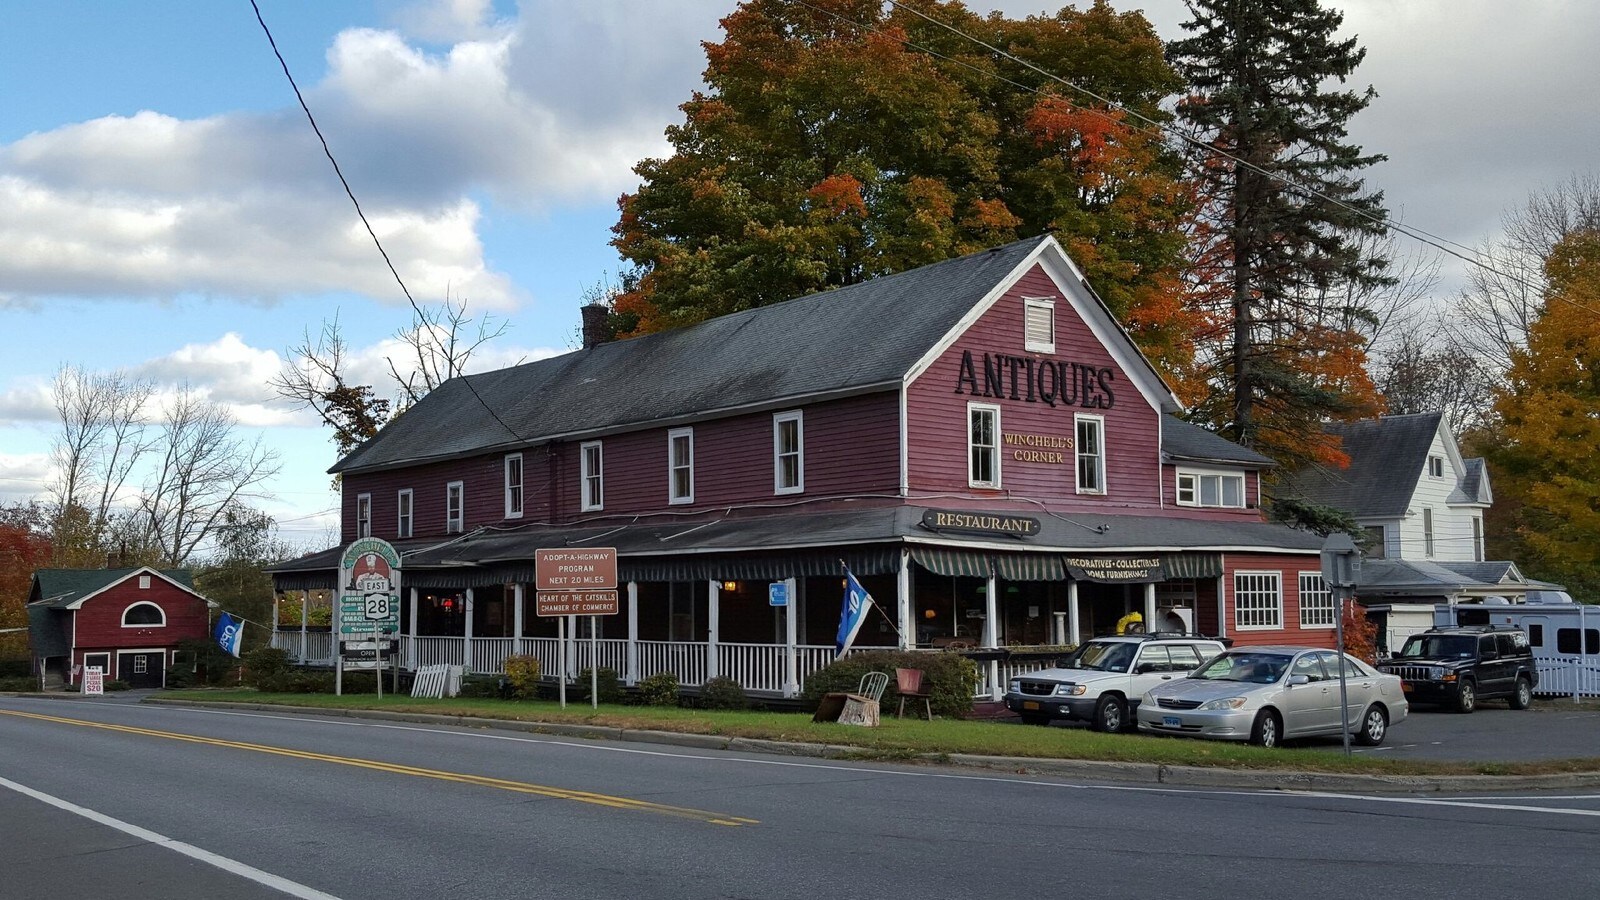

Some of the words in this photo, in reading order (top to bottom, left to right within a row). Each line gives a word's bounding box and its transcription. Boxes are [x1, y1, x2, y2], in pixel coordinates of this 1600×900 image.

[955, 350, 1115, 410] ANTIQUES
[1003, 433, 1074, 449] WINCHELL'S
[1014, 450, 1064, 464] CORNER
[936, 512, 1032, 532] RESTAURANT
[543, 553, 609, 561] ADOPT-A-HIGHWAY
[1116, 558, 1160, 568] COLLECTIBLES
[558, 565, 594, 573] PROGRAM
[1106, 570, 1148, 579] FURNISHINGS
[571, 576, 582, 584] 20
[583, 575, 605, 583] MILES
[366, 581, 385, 590] EAST
[540, 594, 559, 602] HEART
[560, 594, 569, 602] OF
[585, 593, 616, 601] CATSKILLS
[368, 599, 387, 614] 28
[582, 603, 614, 611] COMMERCE
